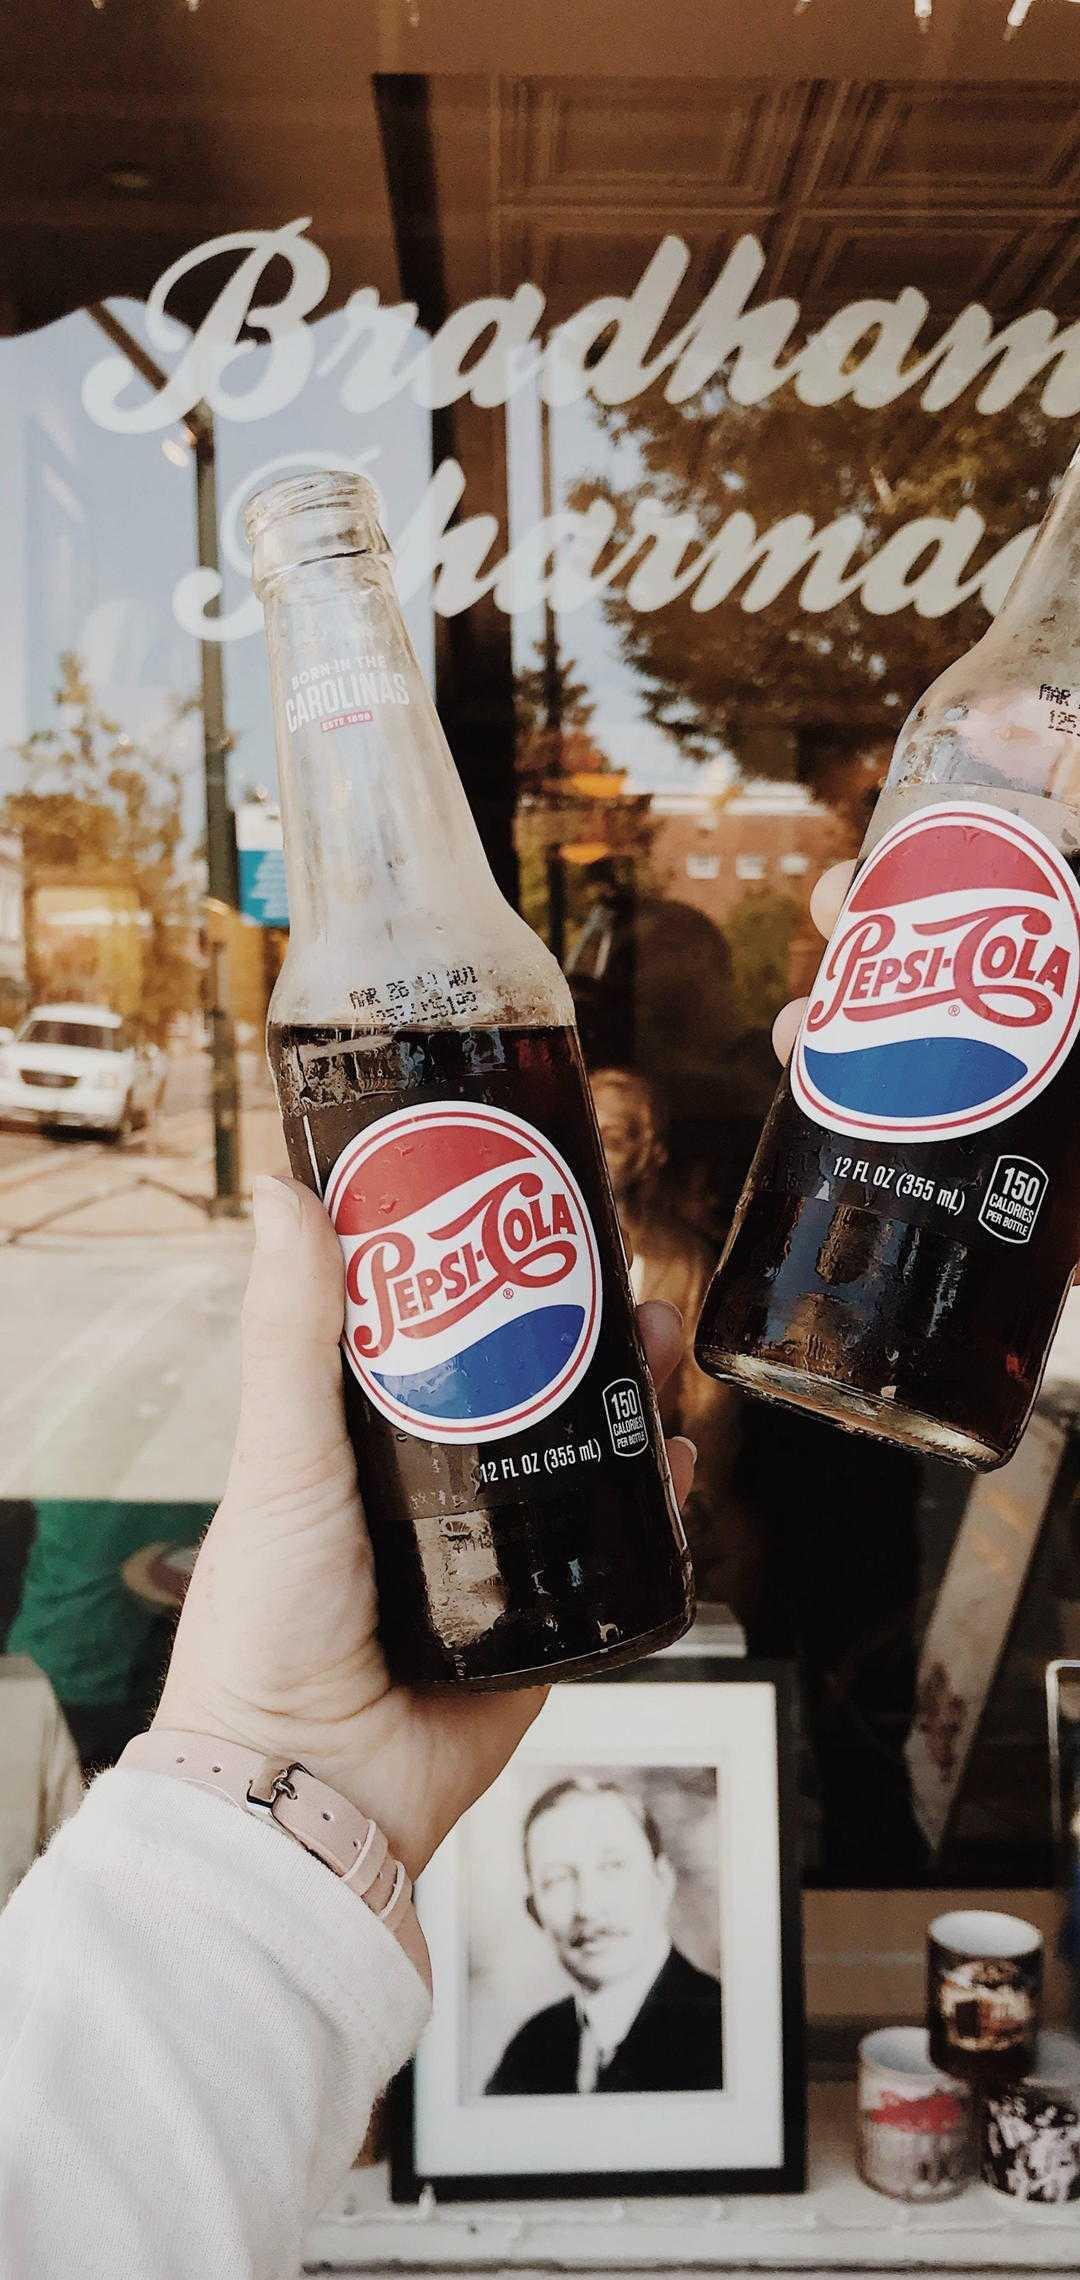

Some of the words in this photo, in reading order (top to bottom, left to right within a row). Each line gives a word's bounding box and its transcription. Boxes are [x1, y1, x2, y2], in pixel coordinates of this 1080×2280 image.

[291, 663, 331, 690] BORN
[333, 657, 353, 673] IN
[357, 656, 387, 669] THE
[286, 672, 410, 734] CAROLINAS
[806, 905, 1072, 1032] PEPSI-COLA
[833, 1156, 851, 1178] 12
[853, 1160, 870, 1183] FL
[873, 1165, 895, 1189] OZ
[895, 1172, 935, 1202] (355
[936, 1187, 966, 1216] mL)
[1002, 1167, 1040, 1206] 150
[985, 1209, 1003, 1225] PER
[1002, 1216, 1029, 1236] BOTTLE
[988, 1193, 1035, 1224] CALORIES
[346, 1172, 578, 1359] PEPSI-COLA
[611, 1388, 639, 1420] 150
[612, 1416, 644, 1437] CALORIES
[616, 1436, 629, 1449] PER
[628, 1432, 645, 1446] BOTTLE
[480, 1461, 499, 1483] 12
[501, 1457, 519, 1479] FL
[521, 1452, 541, 1475] OZ
[543, 1444, 576, 1474] (355
[579, 1438, 602, 1463] mL)
